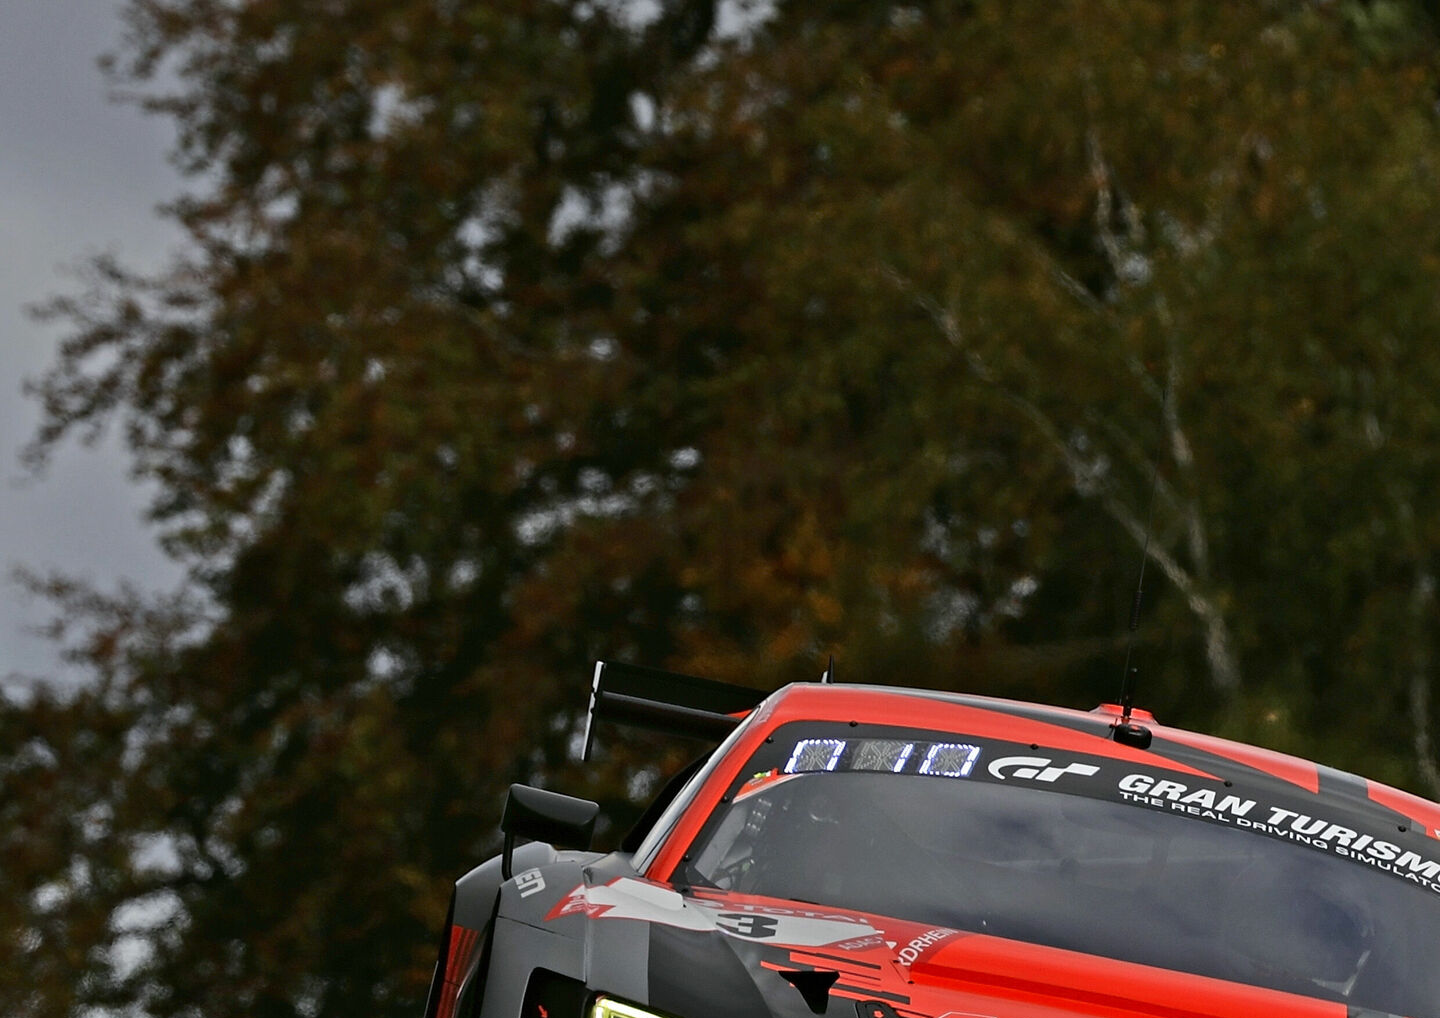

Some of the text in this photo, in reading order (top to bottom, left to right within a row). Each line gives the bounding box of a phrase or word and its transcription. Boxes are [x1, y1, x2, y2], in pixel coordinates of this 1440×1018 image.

[1118, 774, 1256, 817] GRAN
[1119, 791, 1164, 807] THE
[1171, 802, 1230, 823] REAL
[1237, 817, 1328, 850] DRIVING
